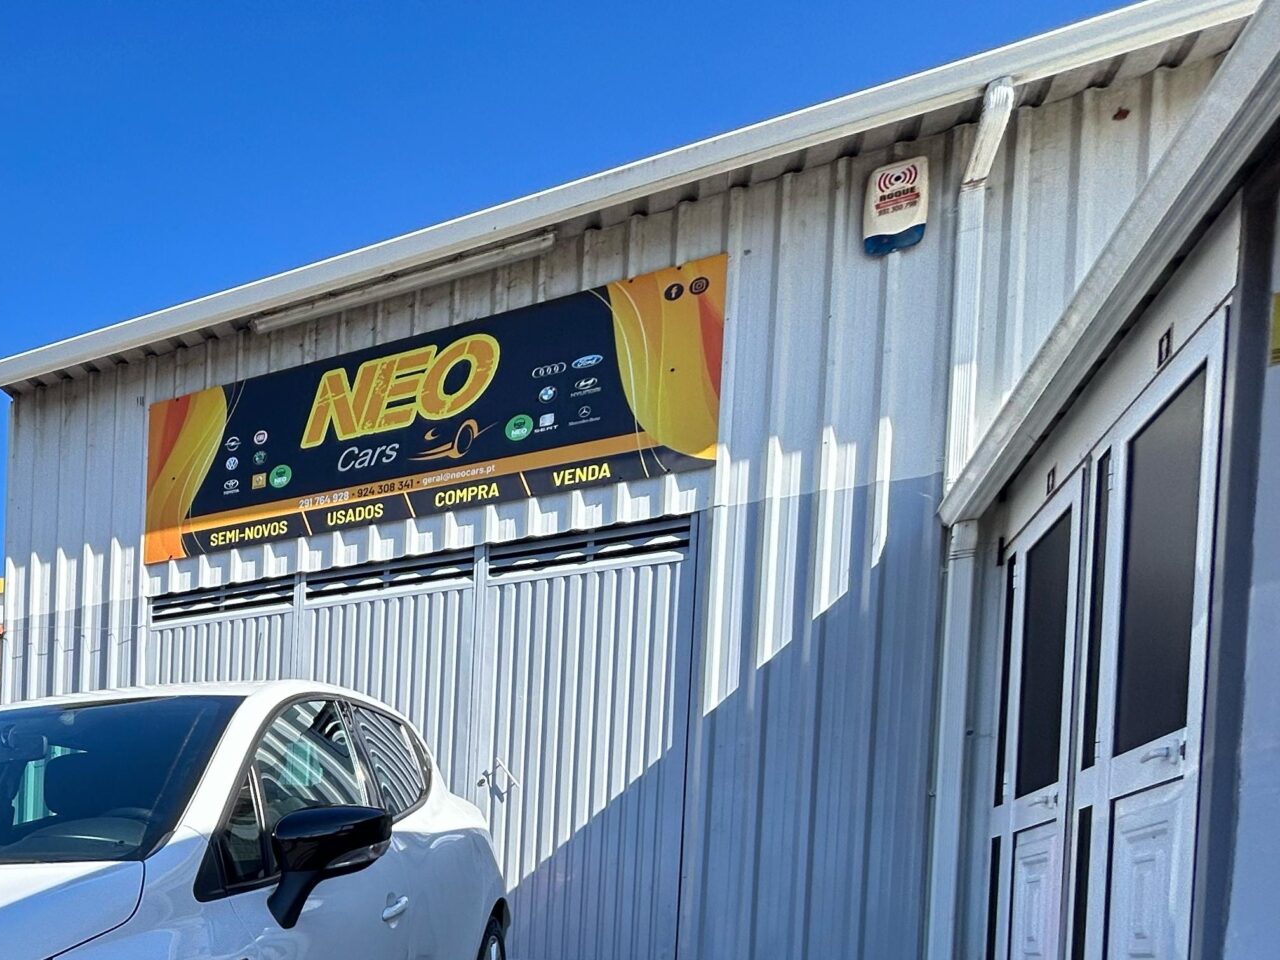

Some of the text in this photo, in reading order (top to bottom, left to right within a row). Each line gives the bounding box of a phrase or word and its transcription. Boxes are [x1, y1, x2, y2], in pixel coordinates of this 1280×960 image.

[300, 334, 500, 449] NEO
[314, 496, 330, 506] 764
[333, 491, 350, 503] 928
[357, 487, 375, 498] 924
[377, 483, 396, 495] 308
[397, 479, 414, 490] 341
[422, 464, 496, 486] geral@neocars.pt
[337, 442, 400, 472] Cars
[210, 462, 611, 547] SEMI-NOVOS USADOS COMPRA VENDA
